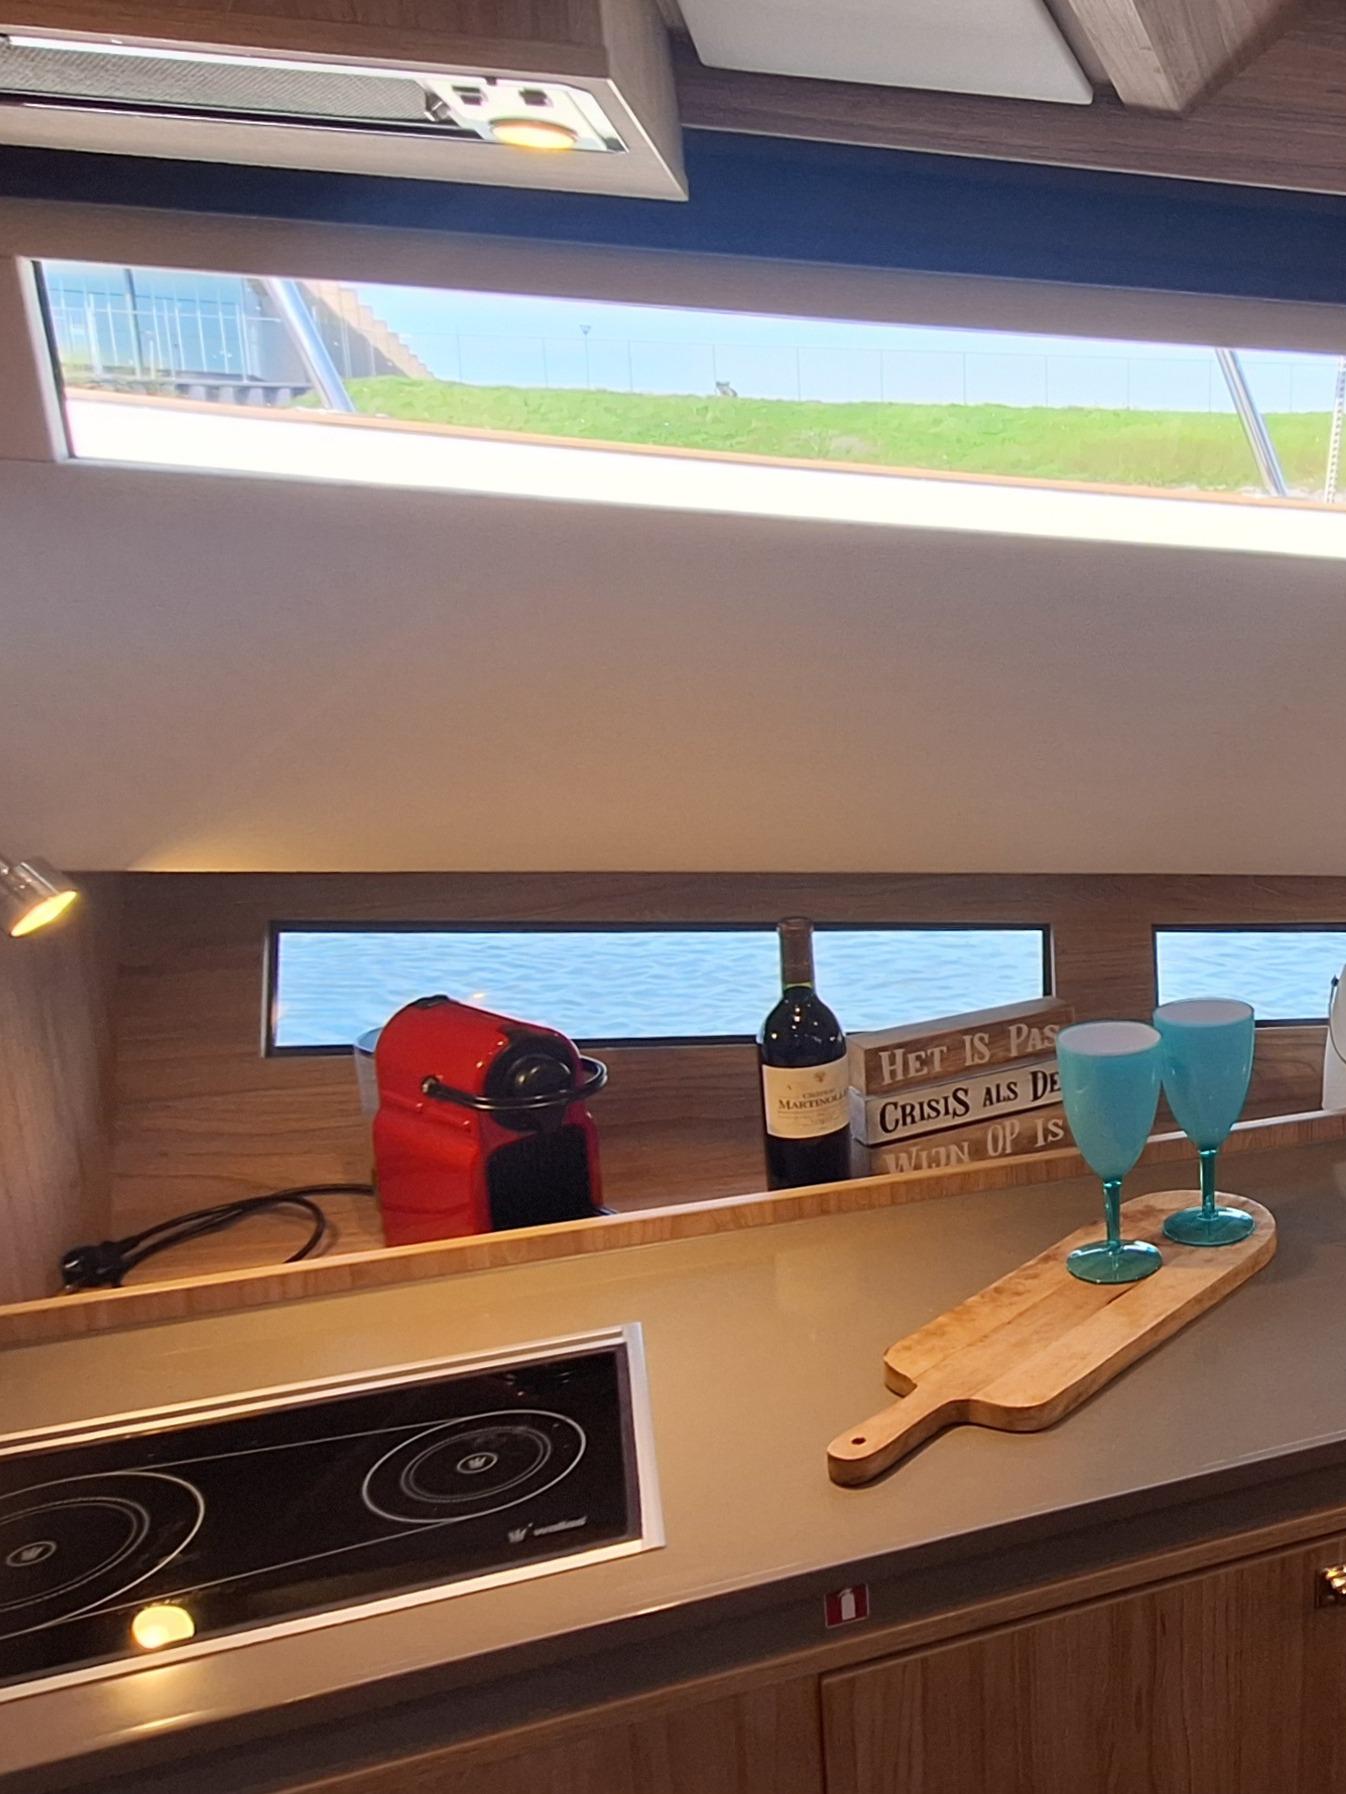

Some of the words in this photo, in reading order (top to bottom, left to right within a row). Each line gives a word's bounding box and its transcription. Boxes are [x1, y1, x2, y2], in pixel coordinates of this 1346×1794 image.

[879, 1046, 948, 1085] HET
[963, 1033, 990, 1067] IS
[1009, 1023, 1060, 1057] PAS
[879, 1087, 970, 1134] CRISIS
[983, 1081, 1018, 1107] ALS
[1030, 1070, 1061, 1102] DE
[883, 1140, 970, 1174] WIJN
[987, 1119, 1020, 1157] OP
[1035, 1118, 1064, 1148] IS
